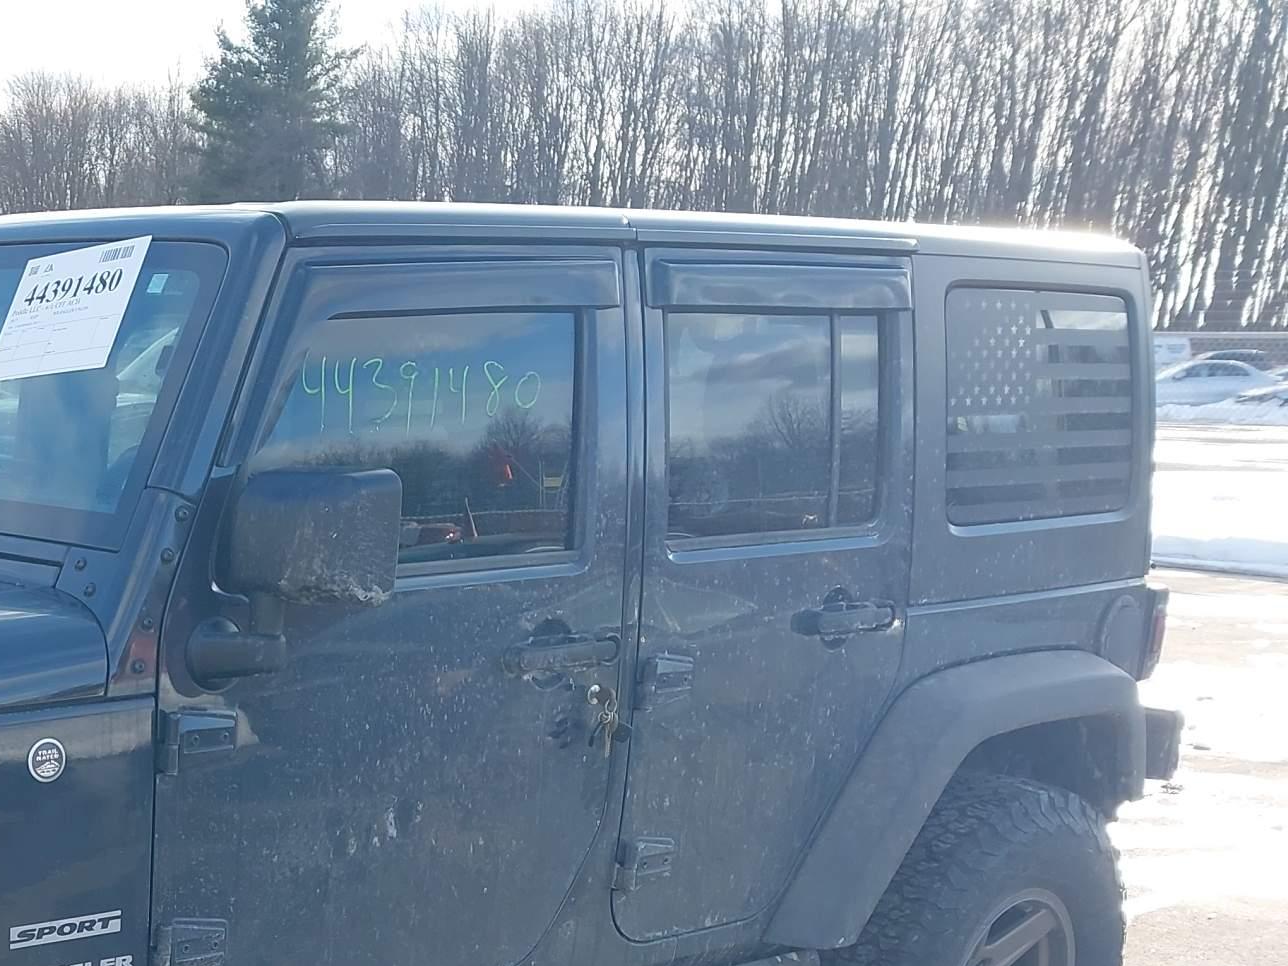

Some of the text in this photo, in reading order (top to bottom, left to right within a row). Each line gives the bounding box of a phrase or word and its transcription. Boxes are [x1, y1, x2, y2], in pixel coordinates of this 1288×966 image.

[24, 268, 123, 306] 44391480
[302, 355, 541, 434] 44391480
[37, 747, 59, 756] TRAIL
[11, 914, 120, 945] SPORT
